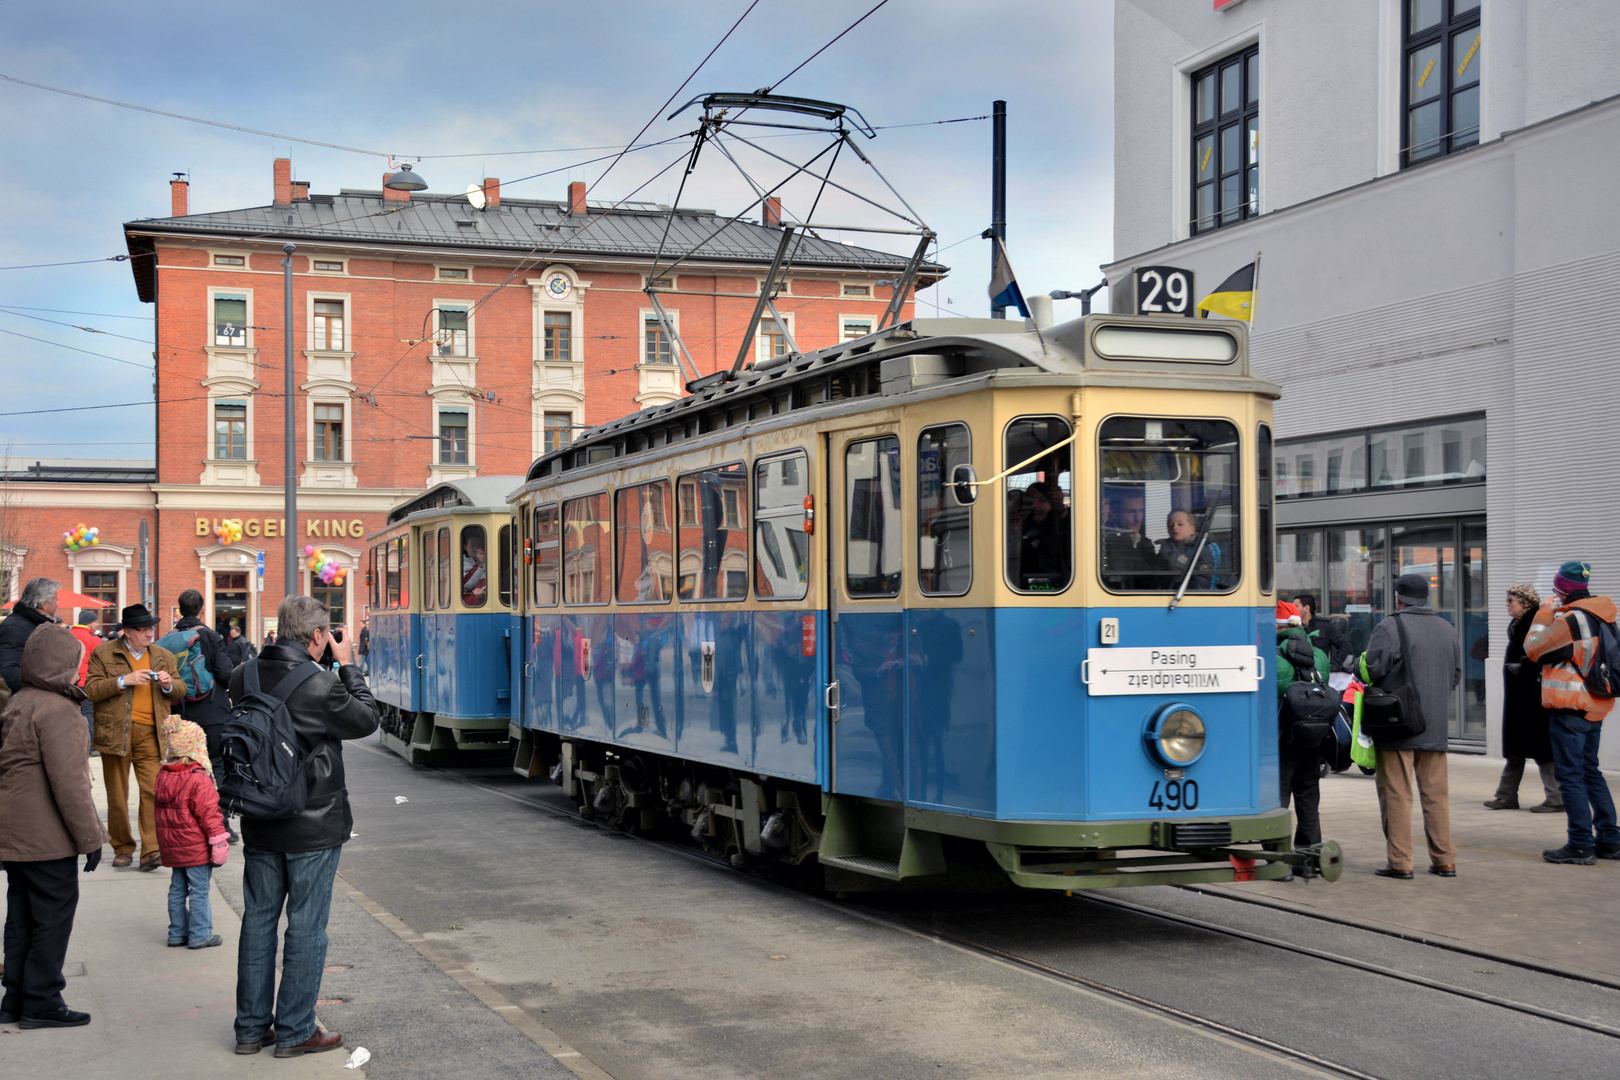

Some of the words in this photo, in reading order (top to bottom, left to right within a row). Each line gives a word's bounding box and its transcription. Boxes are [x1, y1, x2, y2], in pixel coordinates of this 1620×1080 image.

[1418, 59, 1435, 88] SABEL
[1141, 270, 1188, 312] 29
[223, 327, 235, 336] 67
[306, 519, 364, 538] KING
[1104, 624, 1115, 638] 21
[1151, 650, 1196, 667] Pasing
[1128, 671, 1220, 688] Willibaldplatz
[1148, 779, 1198, 811] 490
